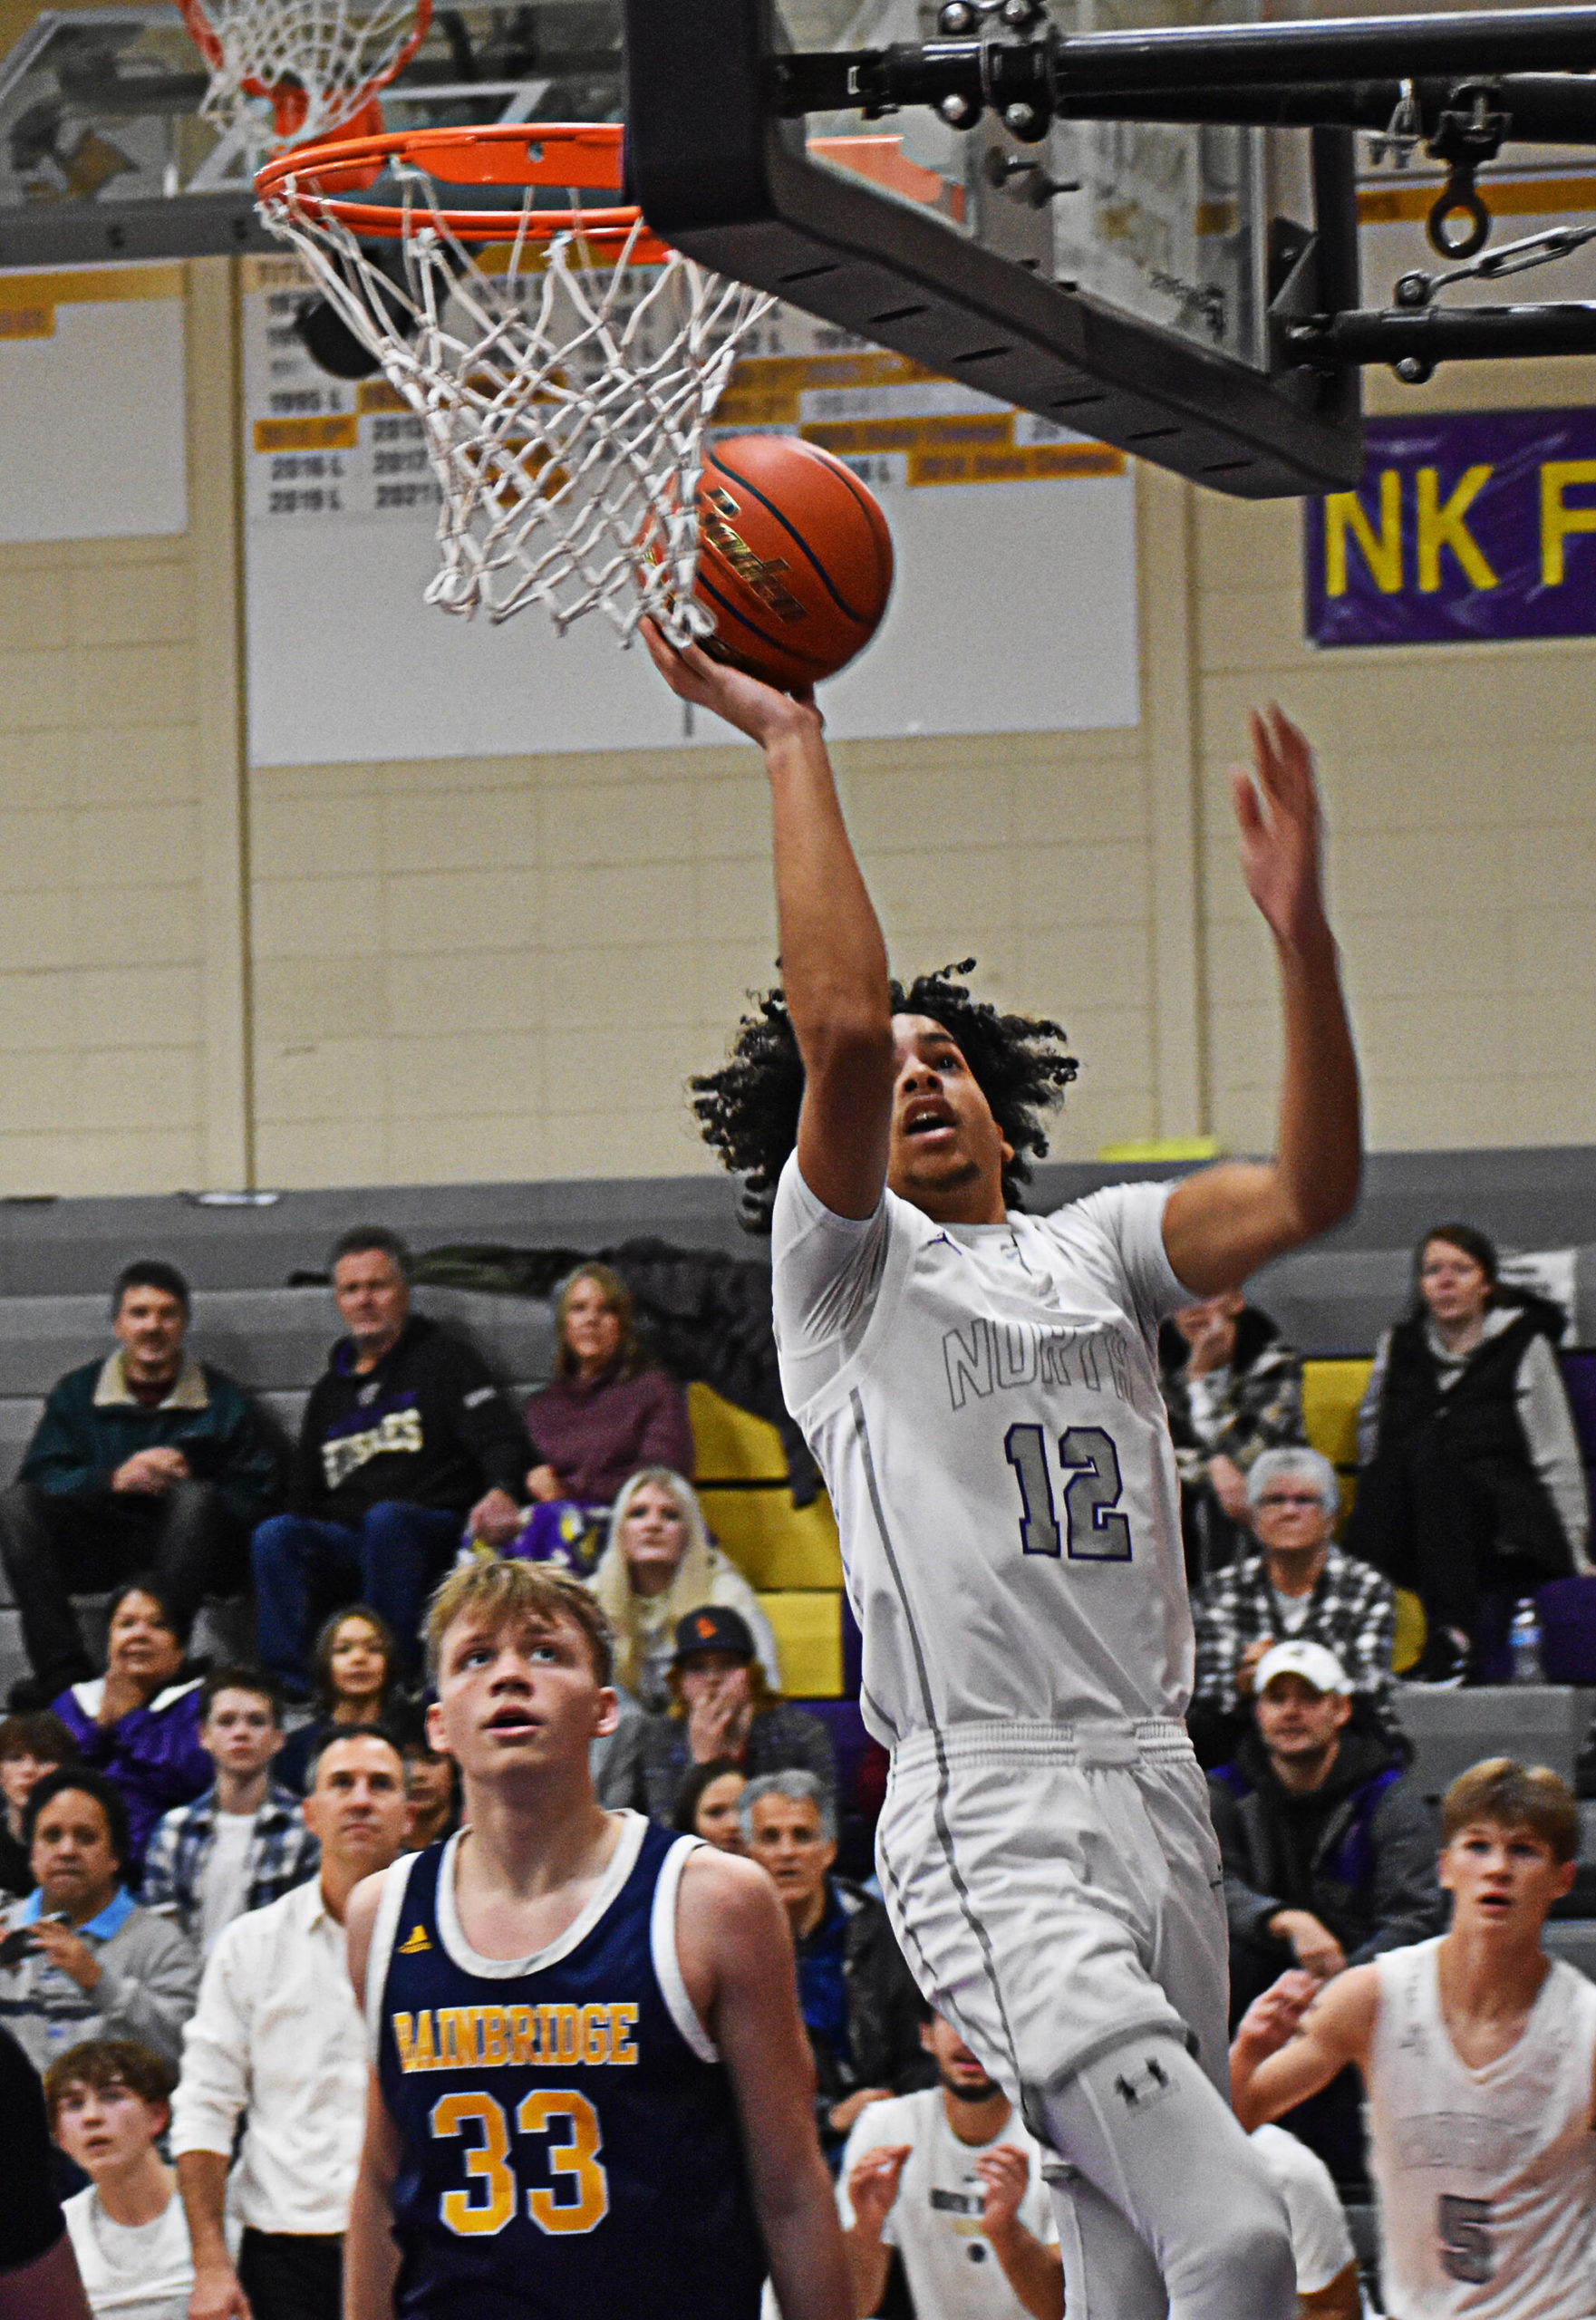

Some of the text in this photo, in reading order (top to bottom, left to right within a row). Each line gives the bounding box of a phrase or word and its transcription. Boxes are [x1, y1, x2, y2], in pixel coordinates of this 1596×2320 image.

[1324, 464, 1498, 596] NK
[1003, 1423, 1132, 1561] 12
[392, 2002, 639, 2074] BAINBRIDGE
[430, 2089, 610, 2236] 33
[1436, 2193, 1495, 2285] 5
